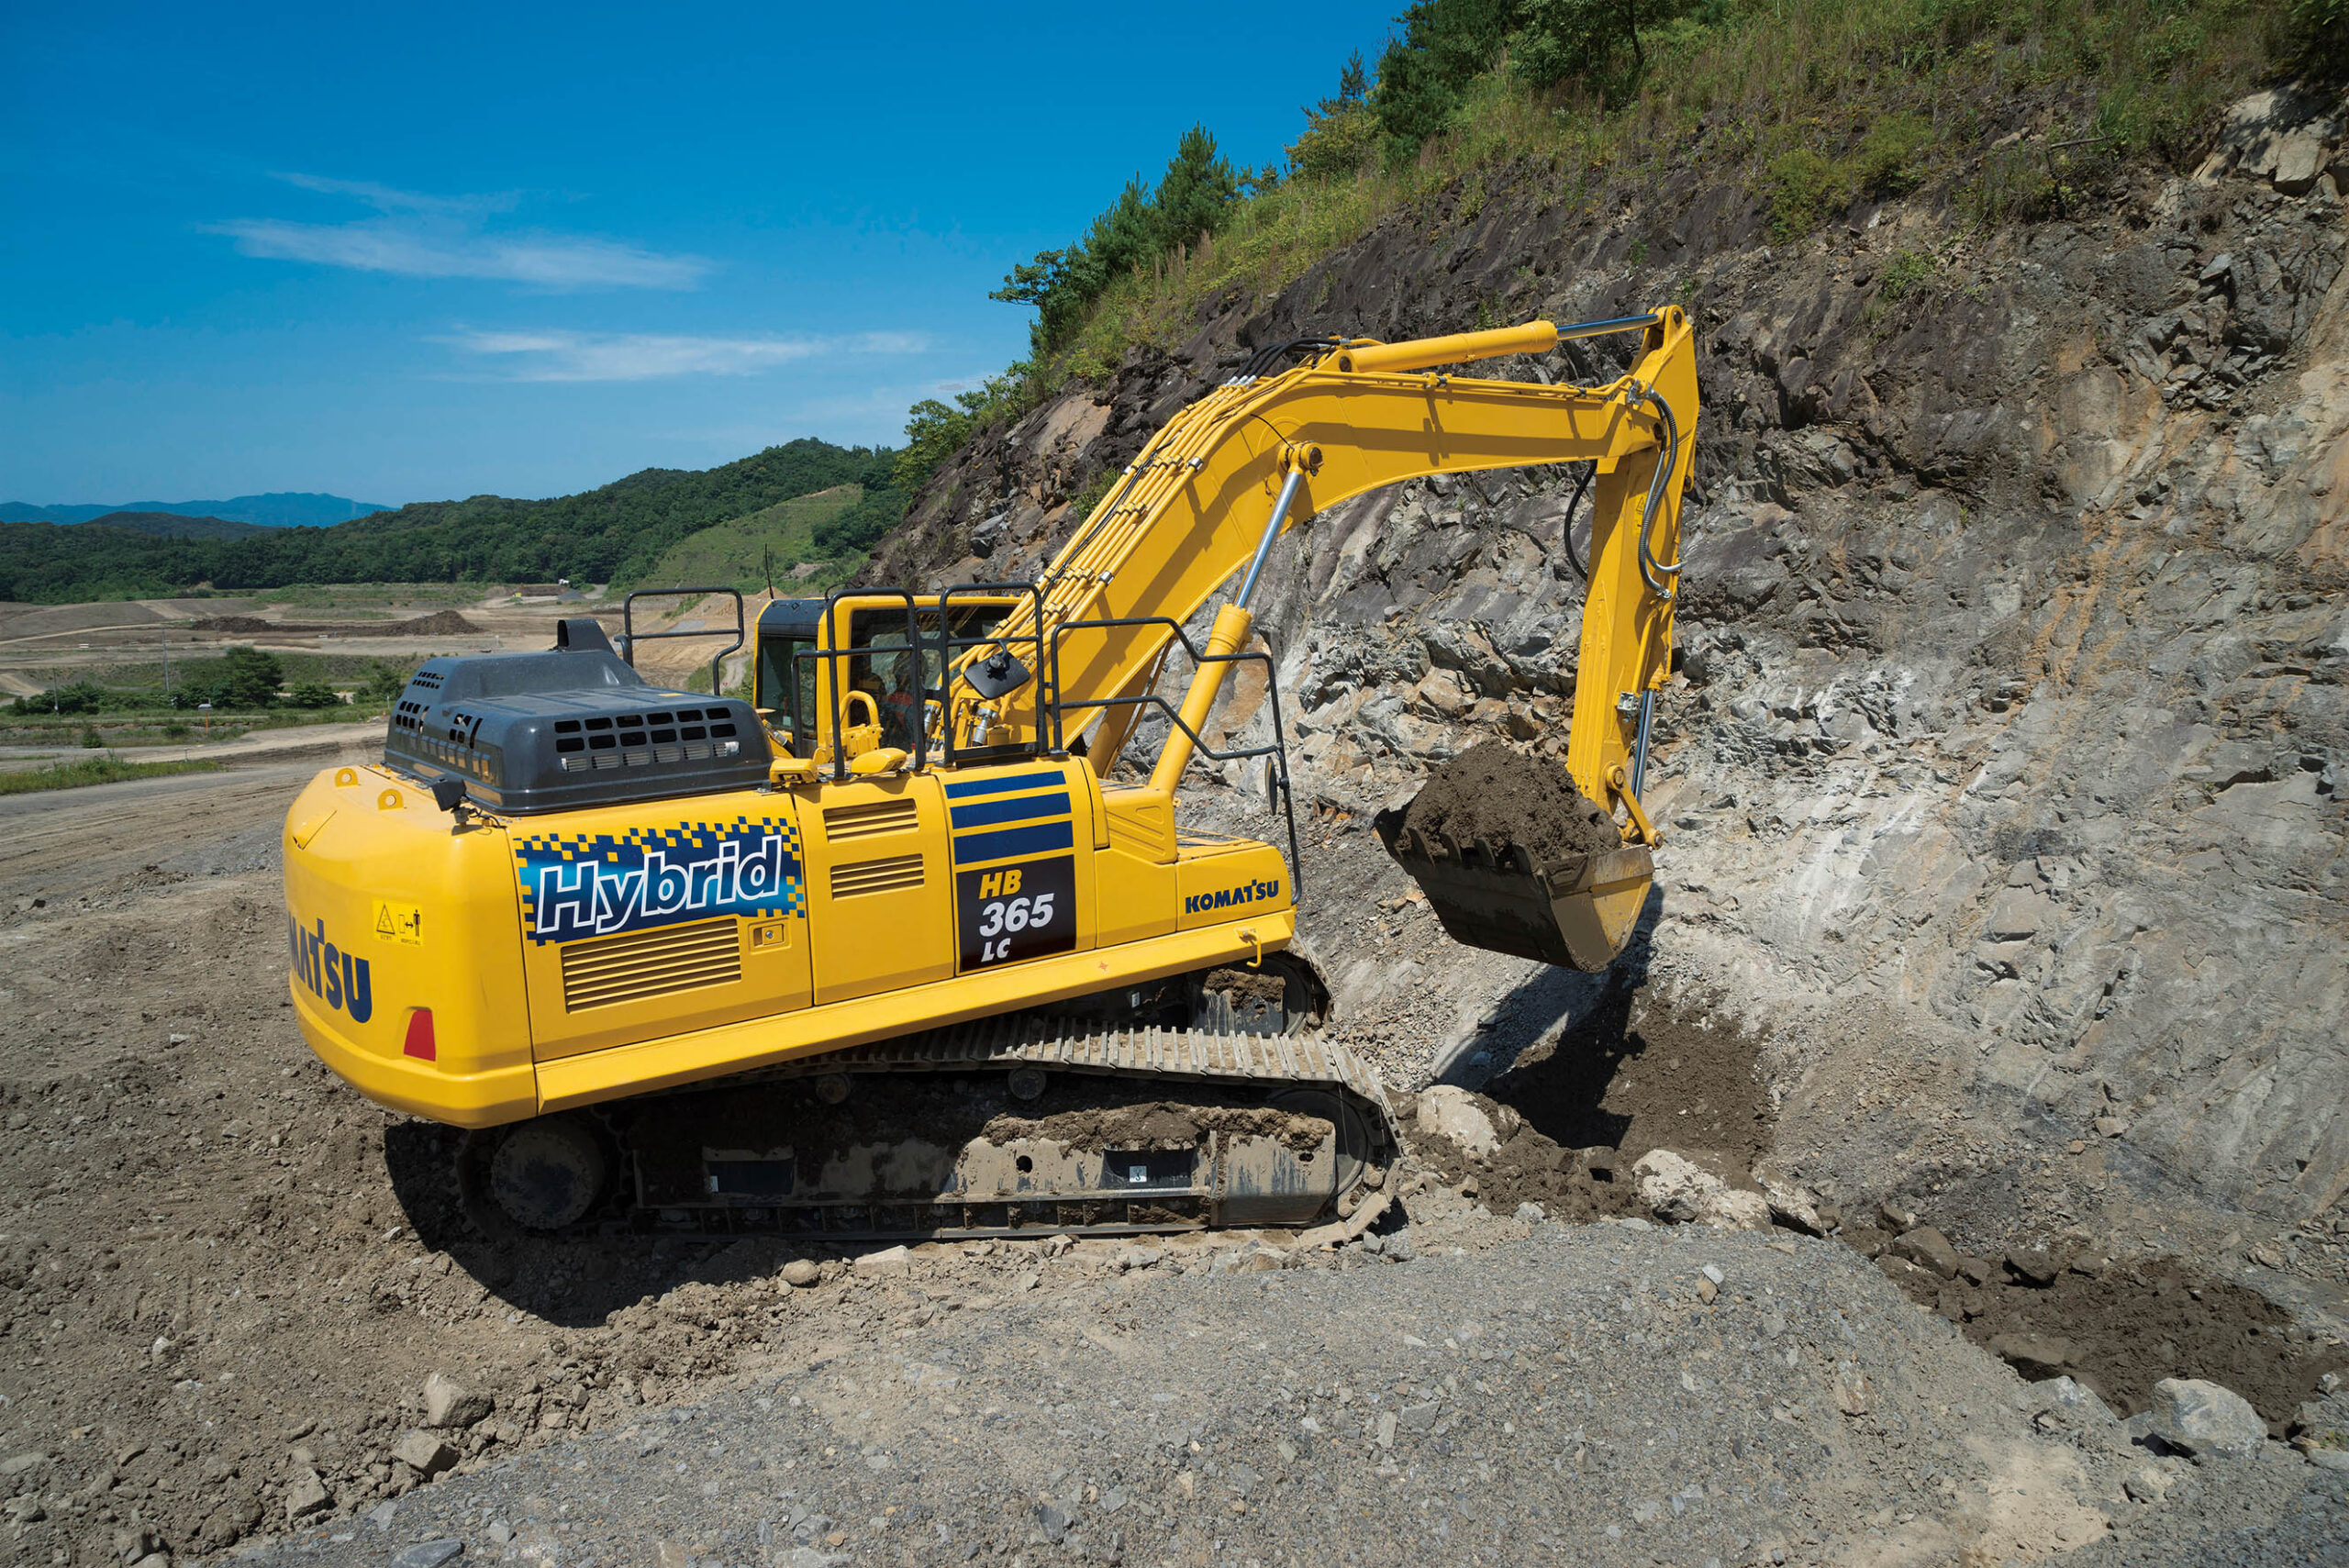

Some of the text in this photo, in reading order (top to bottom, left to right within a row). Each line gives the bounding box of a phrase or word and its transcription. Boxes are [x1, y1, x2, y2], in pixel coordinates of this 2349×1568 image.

[537, 835, 782, 934] Hybrid
[979, 869, 1022, 899] HB
[1186, 879, 1279, 914] KOMATSU
[979, 893, 1055, 937] 365
[981, 938, 1011, 962] LC
